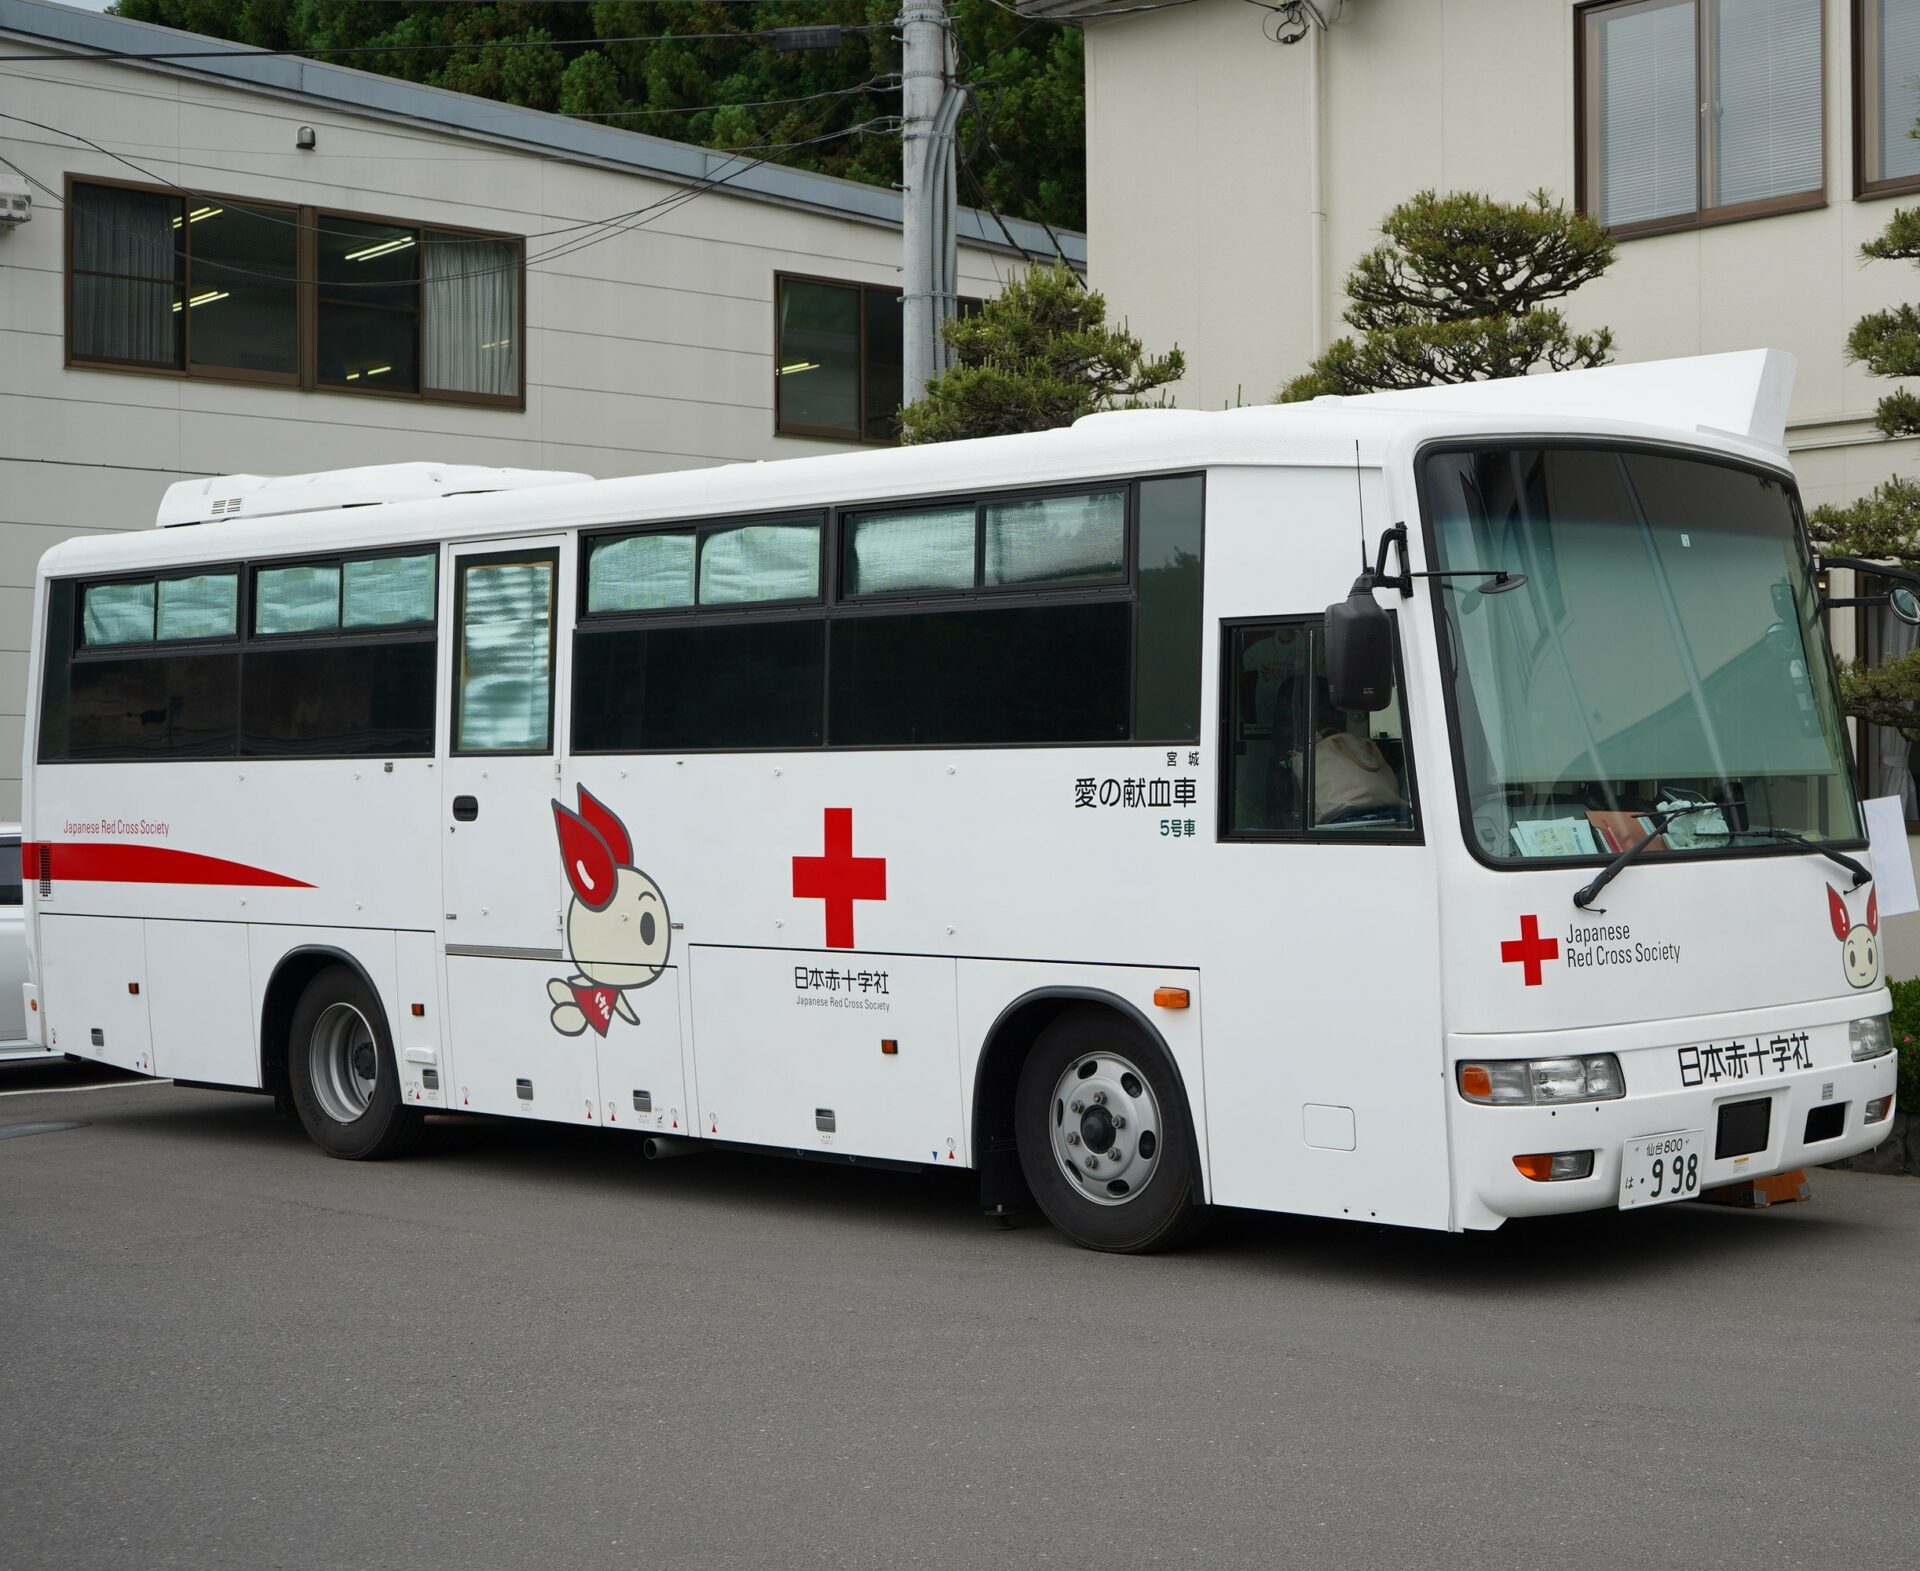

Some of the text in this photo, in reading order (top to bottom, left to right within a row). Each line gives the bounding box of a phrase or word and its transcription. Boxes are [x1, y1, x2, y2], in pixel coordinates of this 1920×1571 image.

[1075, 777, 1197, 808] 愛の献血車
[64, 819, 170, 838] Japanese Red Cross Society
[1160, 818, 1196, 837] 5号車
[1566, 923, 1630, 947] Japanese
[1567, 941, 1680, 968] Red Cross Society
[795, 966, 889, 994] 日本赤十字社
[796, 996, 890, 1013] Japanese Red Cross Society
[1678, 1031, 1813, 1087] 日本赤十字社
